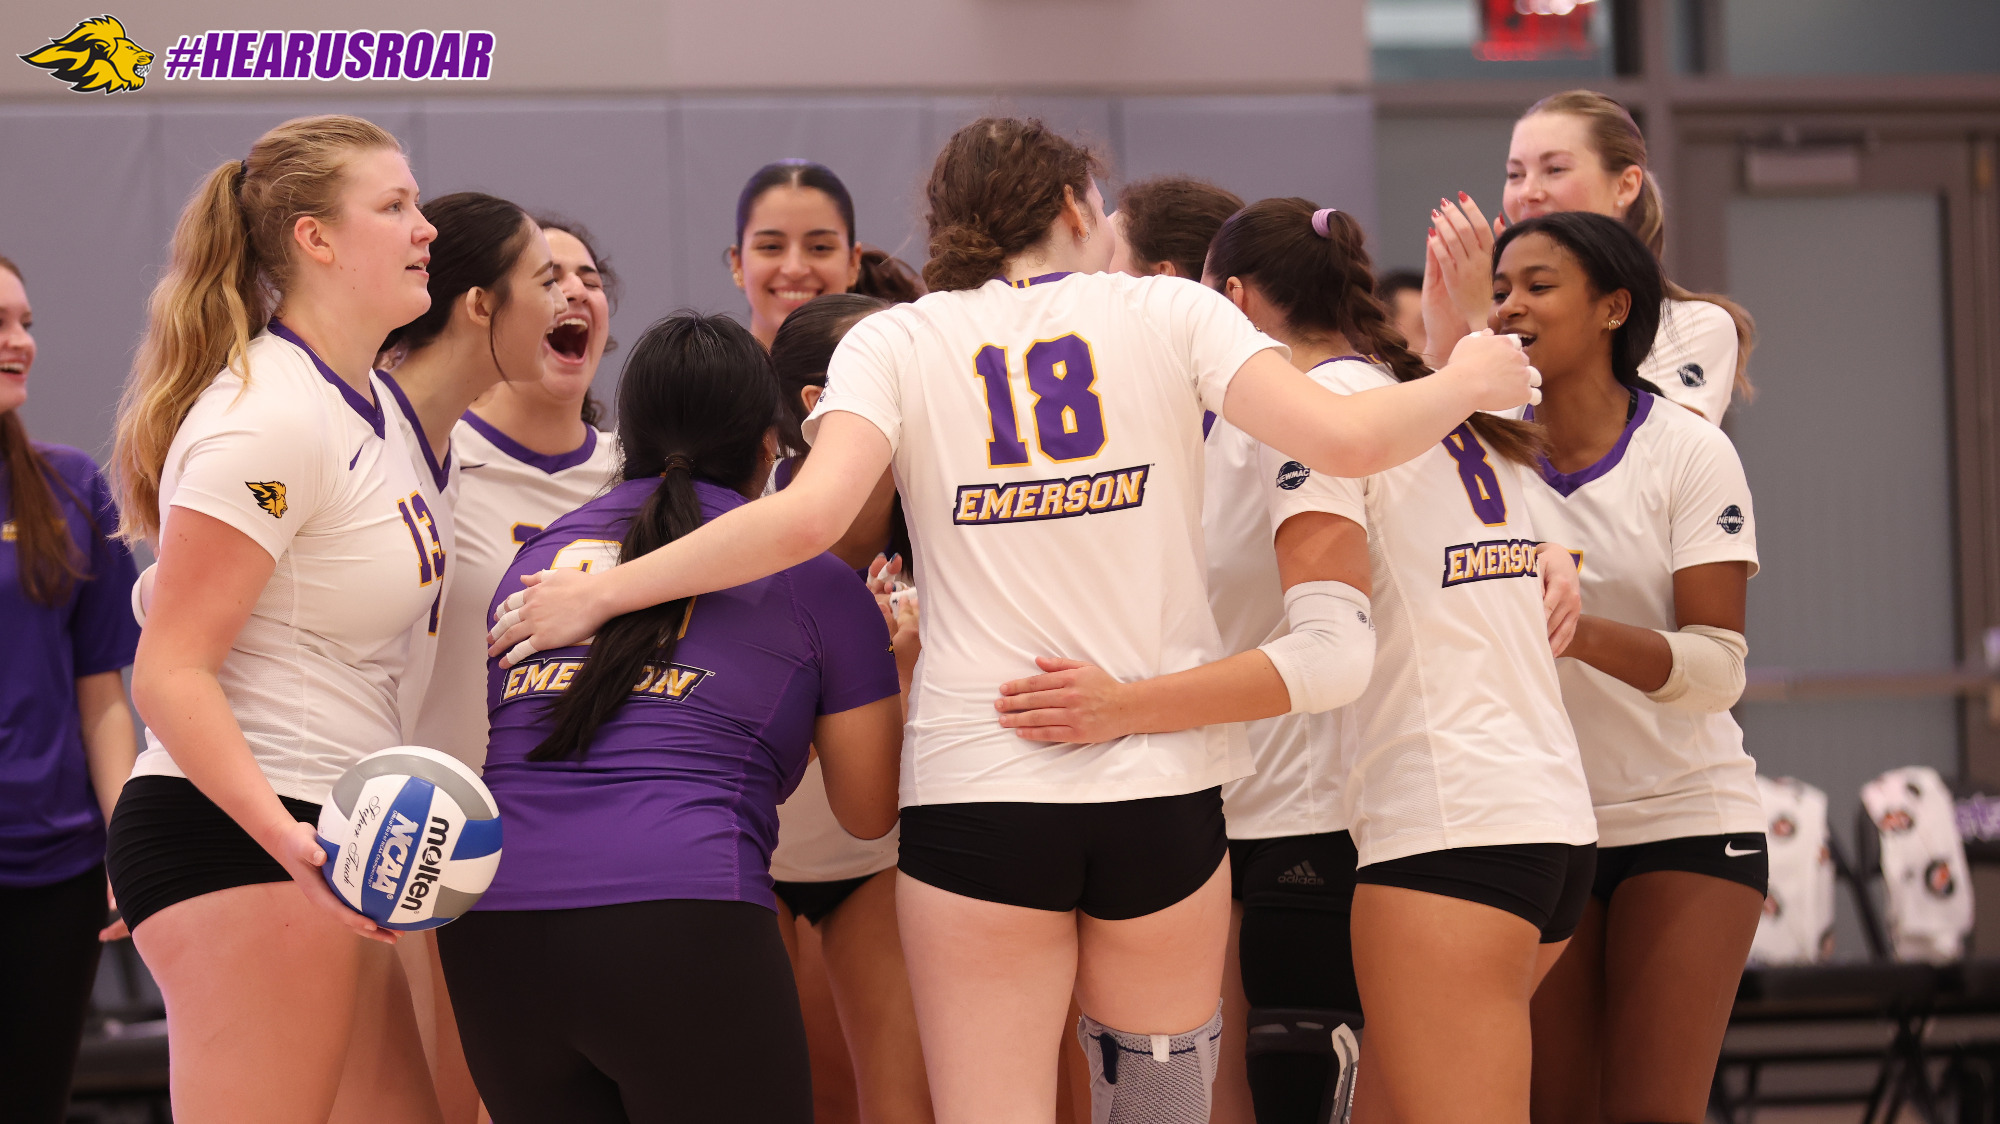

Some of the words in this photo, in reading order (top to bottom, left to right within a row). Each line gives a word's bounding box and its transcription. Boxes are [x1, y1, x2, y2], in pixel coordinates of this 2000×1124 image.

[972, 331, 1109, 469] 18
[954, 469, 1145, 522] EMERSON
[1441, 421, 1508, 527] 8
[397, 489, 446, 588] 13
[503, 661, 699, 701] EMEON
[353, 796, 381, 838] Super
[372, 812, 419, 895] NCAA
[343, 842, 359, 888] Touch
[400, 815, 450, 912] molten
